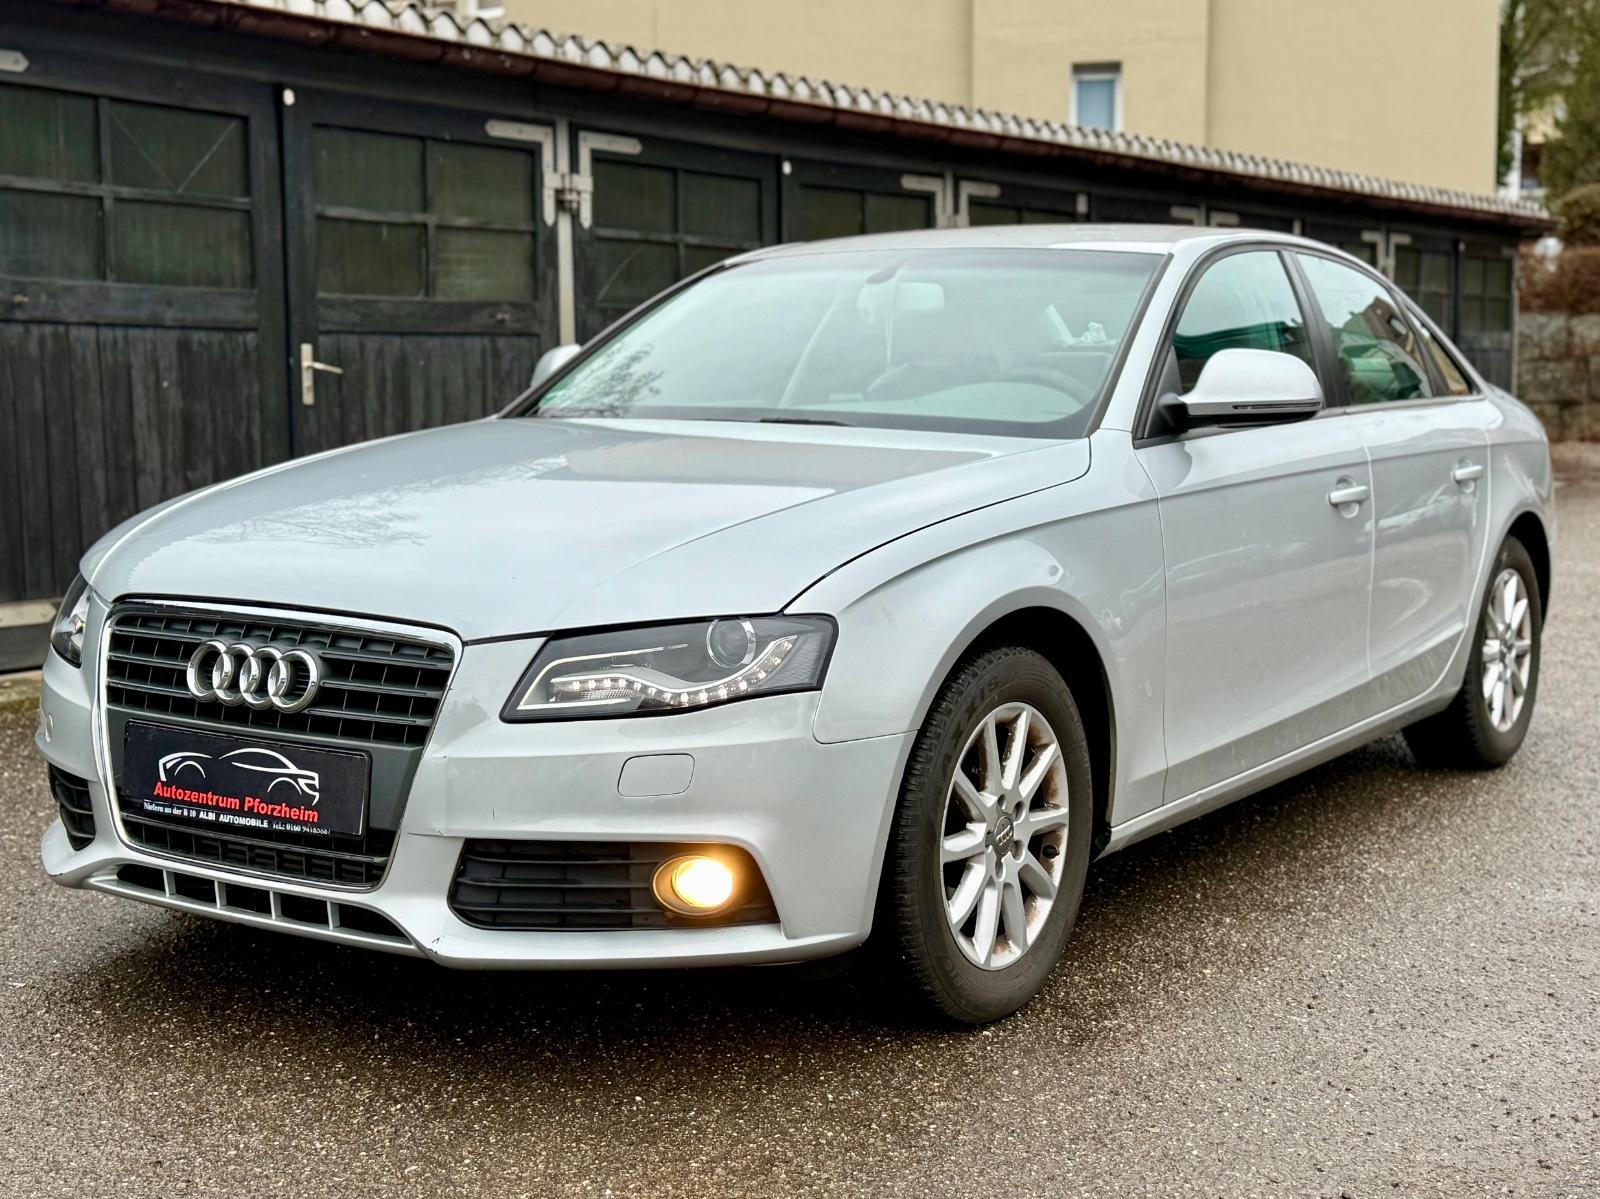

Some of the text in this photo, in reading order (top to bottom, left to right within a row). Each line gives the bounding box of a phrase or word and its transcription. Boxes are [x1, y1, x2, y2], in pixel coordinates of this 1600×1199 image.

[153, 781, 319, 823] Autozentrum Pforzheim
[172, 807, 182, 816] der
[199, 810, 216, 821] ALBI
[218, 813, 269, 828] AUTOMOBILE
